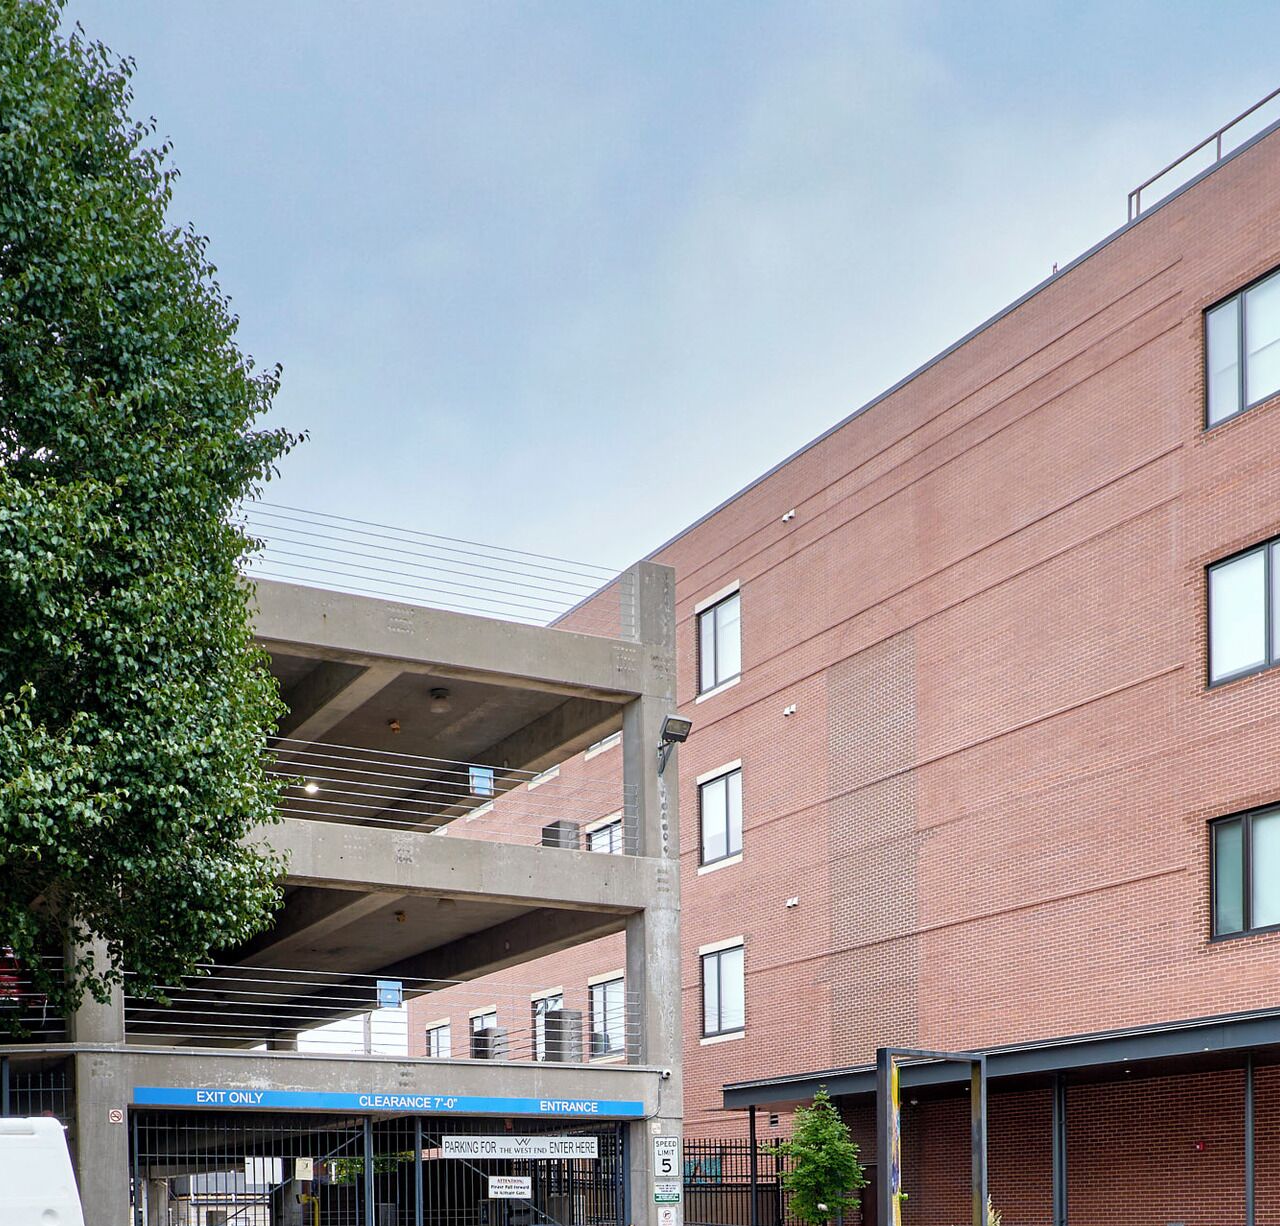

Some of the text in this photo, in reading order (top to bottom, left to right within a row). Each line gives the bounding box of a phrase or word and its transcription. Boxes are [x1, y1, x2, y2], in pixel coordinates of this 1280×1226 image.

[196, 1091, 264, 1104] EXIT ONLY
[359, 1095, 431, 1108] CLEARANCE
[539, 1101, 598, 1113] ENTRANCE
[444, 1141, 479, 1154] PARKING
[480, 1141, 496, 1154] FOR
[549, 1141, 574, 1154] ENTER
[575, 1141, 595, 1154] HERE
[662, 1158, 672, 1173] 5
